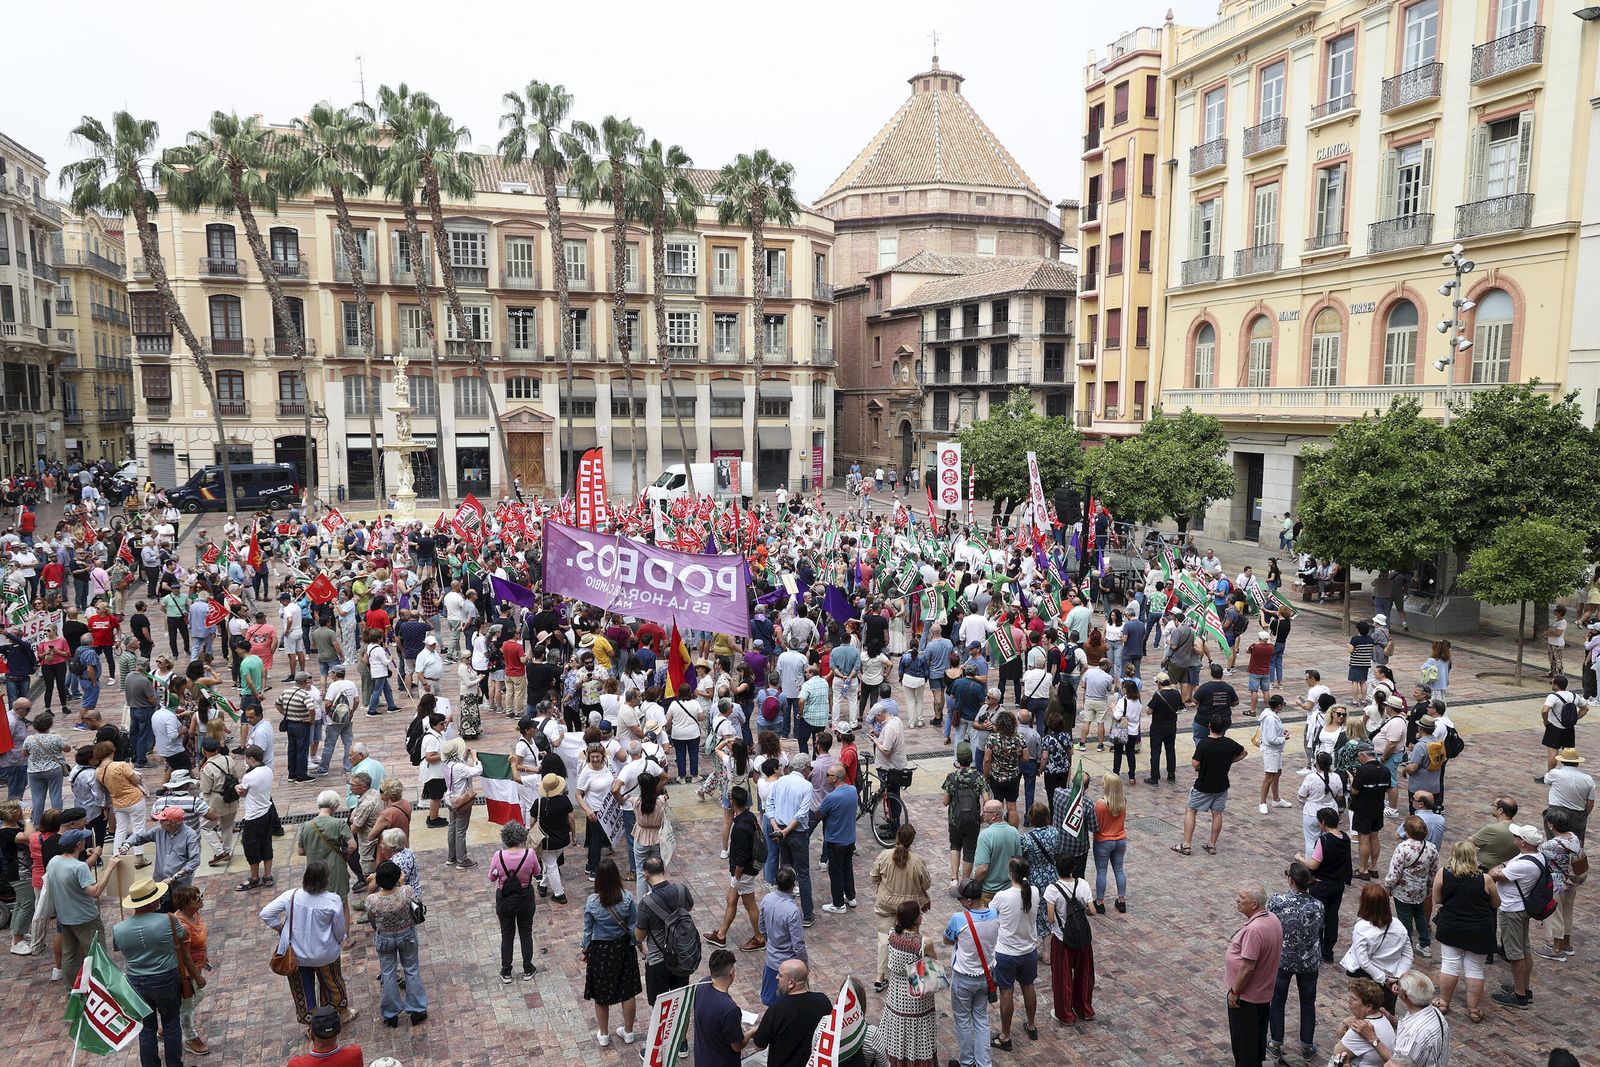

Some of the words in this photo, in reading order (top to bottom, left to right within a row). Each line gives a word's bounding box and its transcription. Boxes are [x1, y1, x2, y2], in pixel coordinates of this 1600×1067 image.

[1350, 302, 1376, 315] TORRES
[580, 460, 591, 524] CCOO
[594, 458, 606, 520] CCOO
[997, 630, 1010, 652] CCOO
[664, 997, 680, 1040] Málaga
